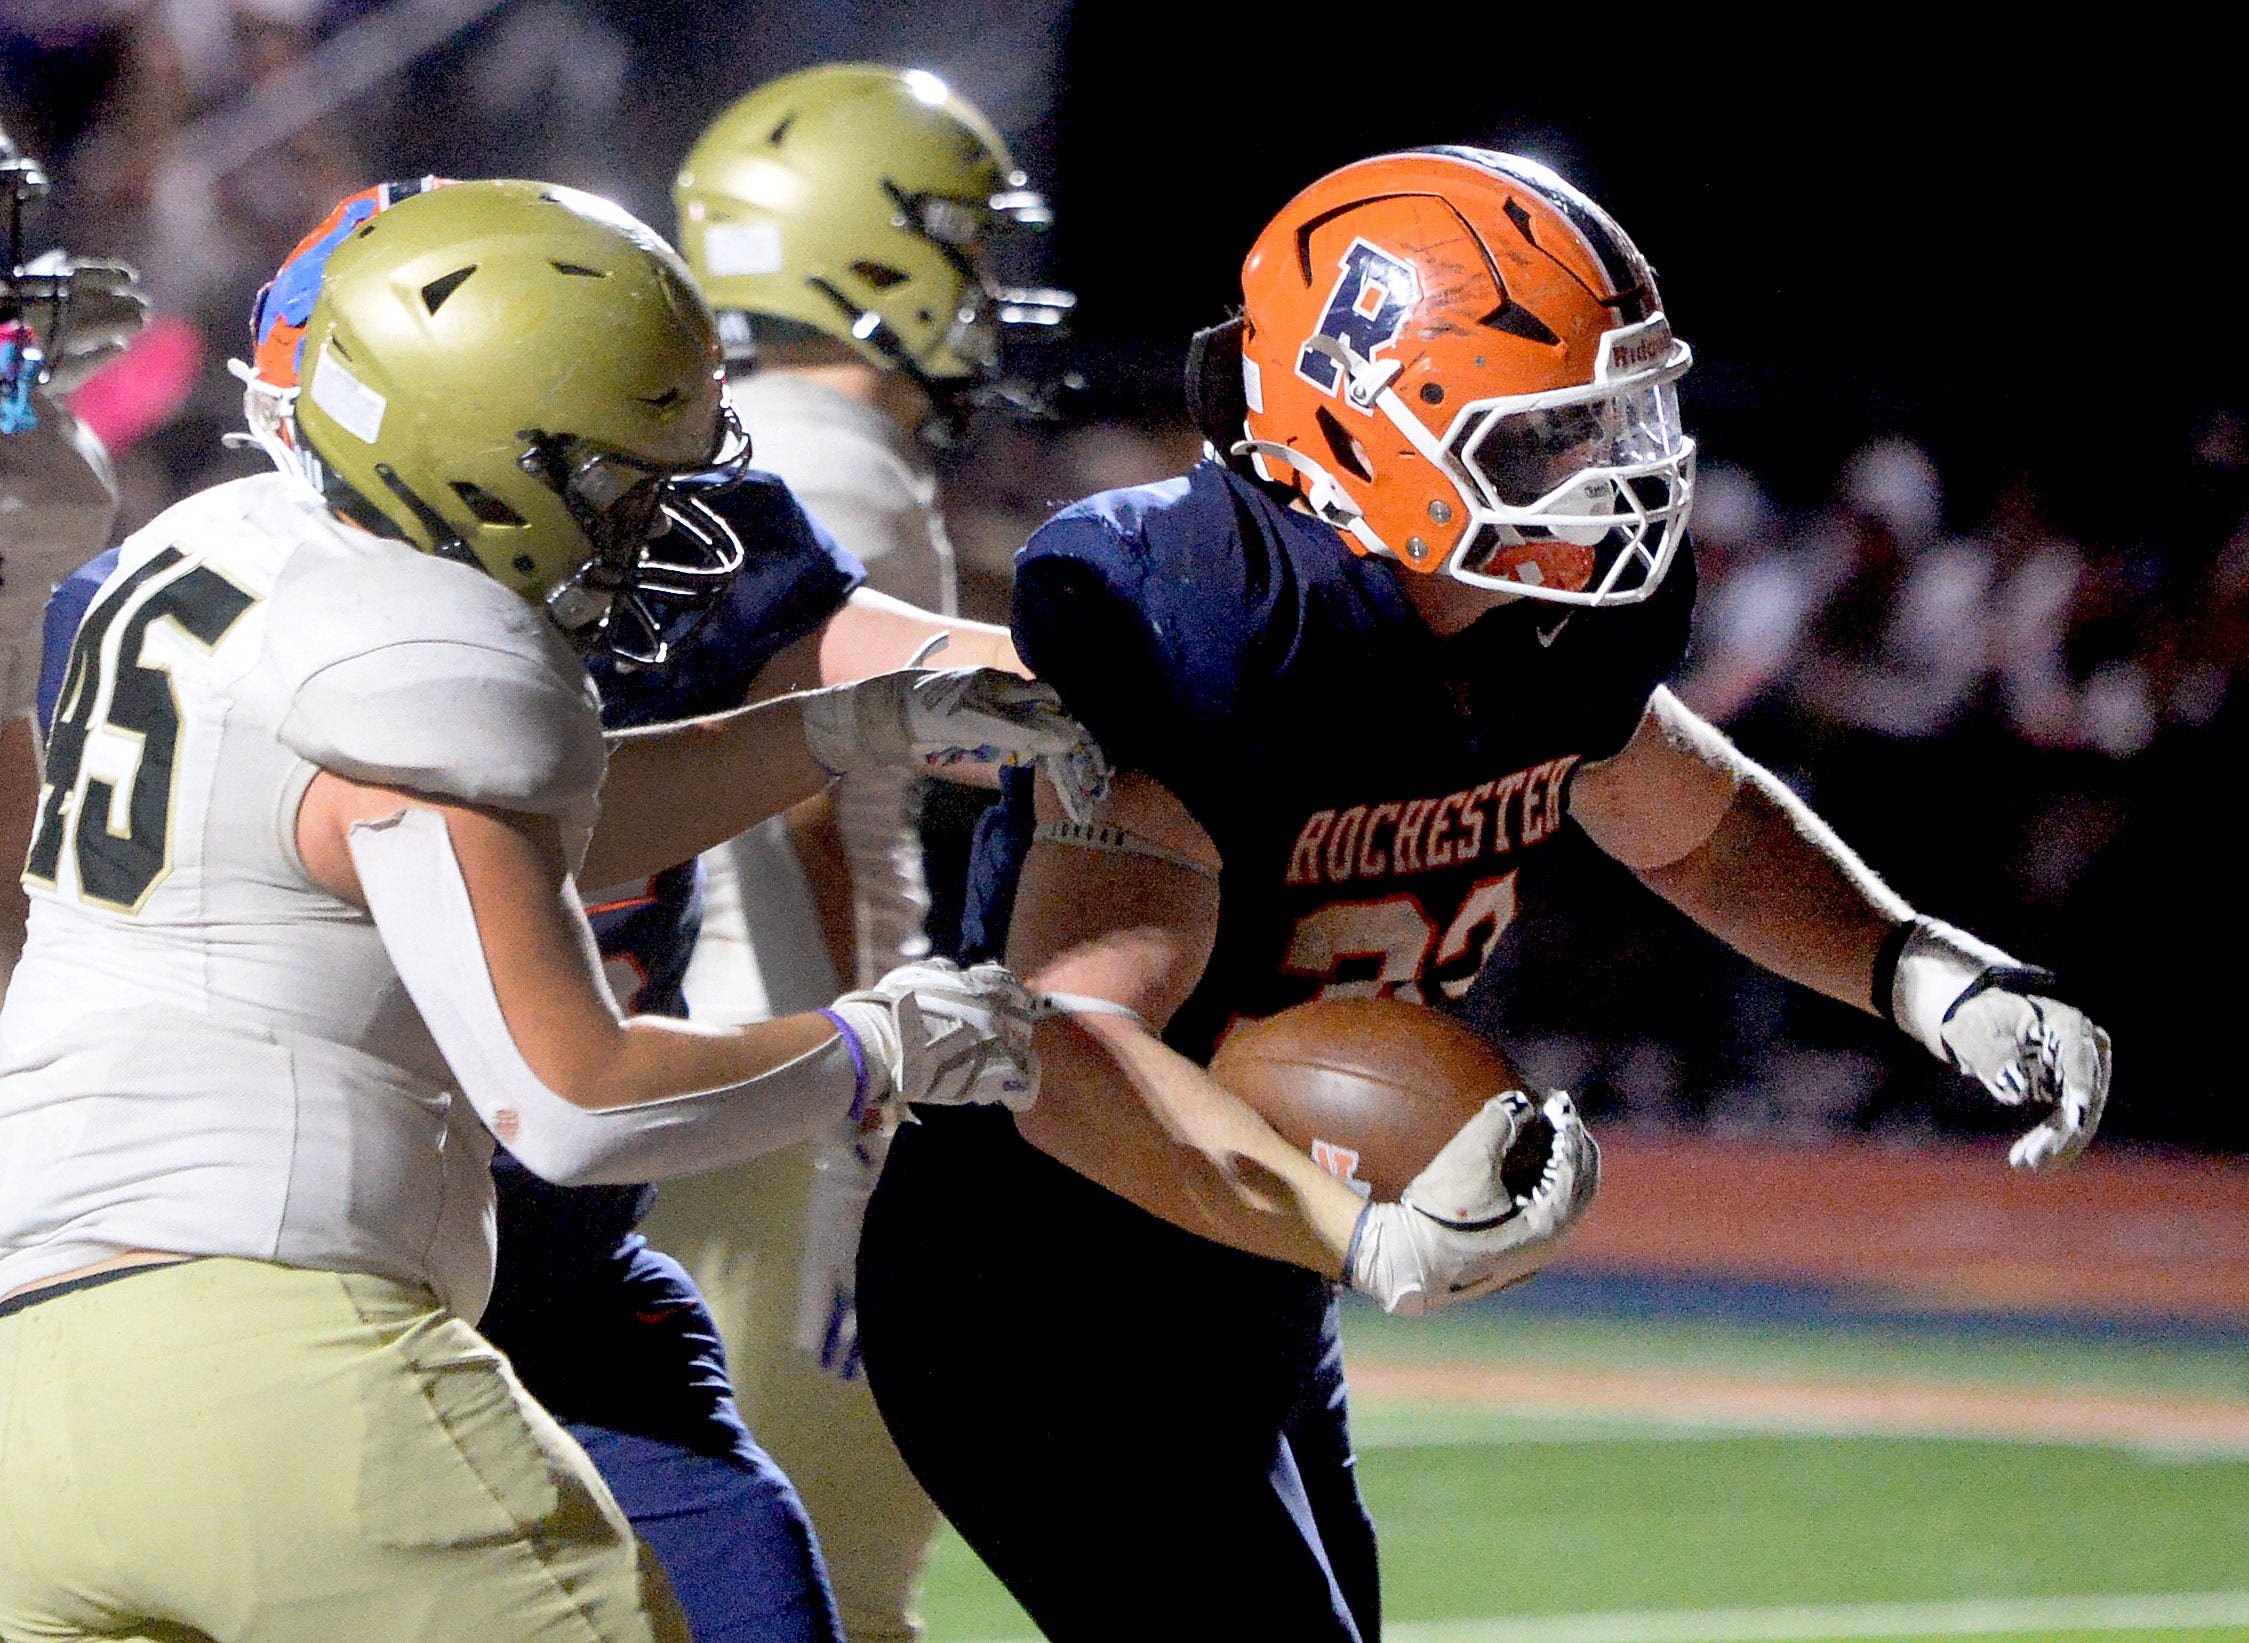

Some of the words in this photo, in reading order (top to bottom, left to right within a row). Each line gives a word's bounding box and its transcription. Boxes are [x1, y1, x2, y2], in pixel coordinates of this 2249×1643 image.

[1295, 235, 1423, 418] R
[20, 543, 266, 915] 45
[1284, 754, 1581, 884] ROCHESTER
